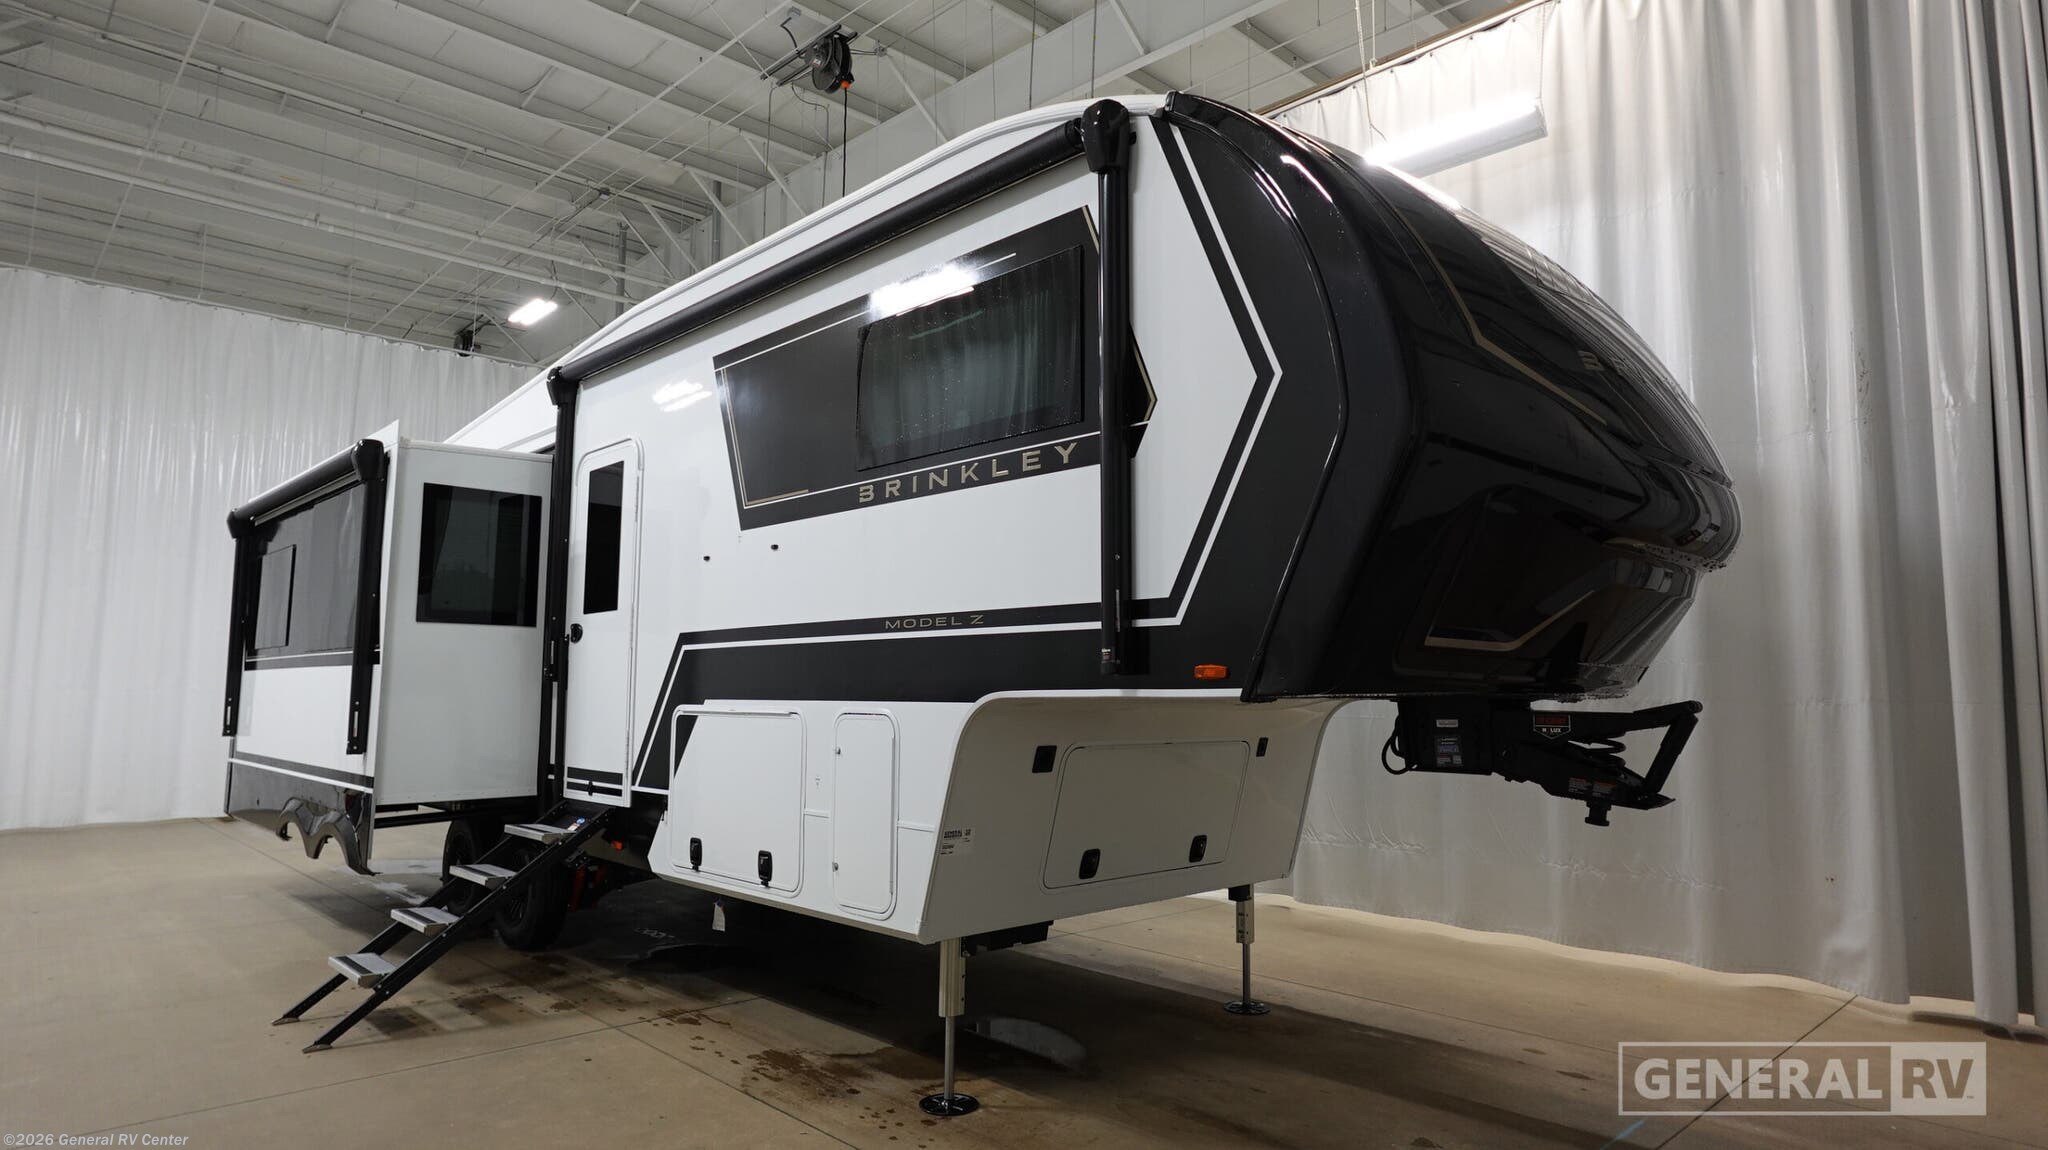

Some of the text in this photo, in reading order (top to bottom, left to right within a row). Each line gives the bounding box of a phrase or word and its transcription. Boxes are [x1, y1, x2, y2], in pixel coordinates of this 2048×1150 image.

[859, 442, 1078, 503] BRINKLEY
[884, 614, 984, 630] MODEL Z
